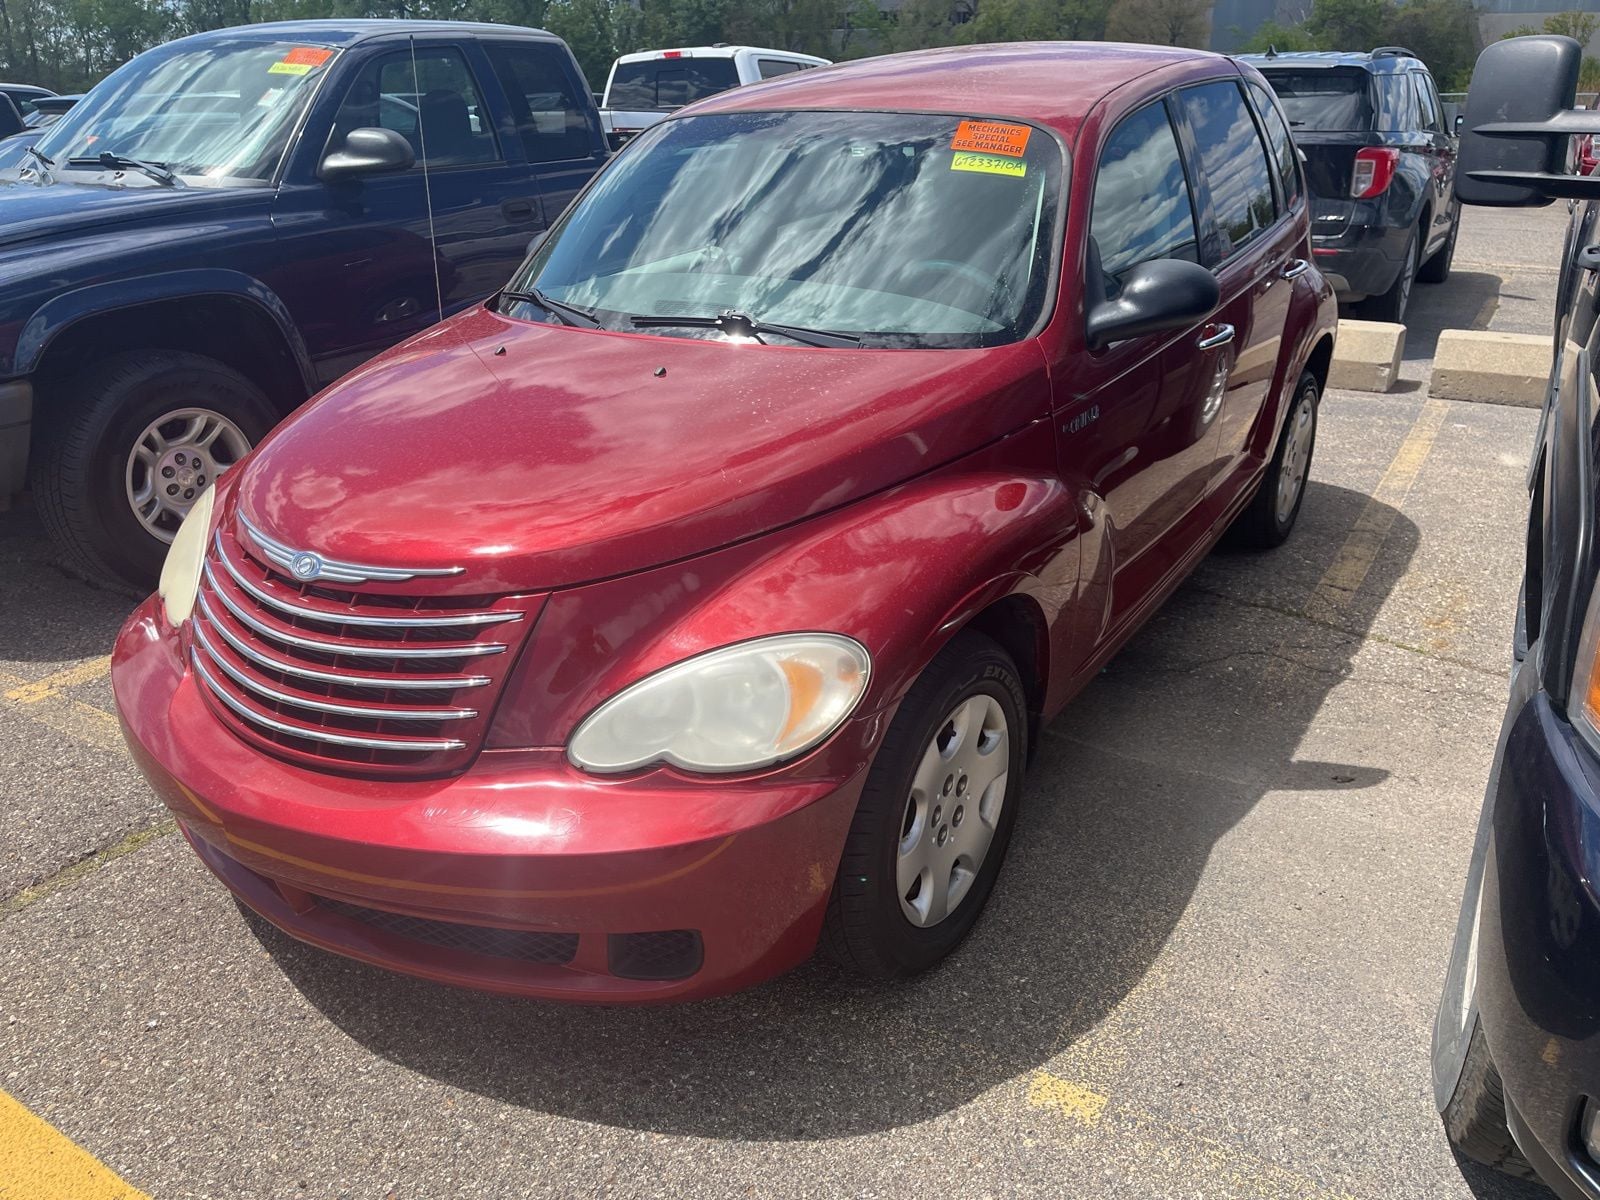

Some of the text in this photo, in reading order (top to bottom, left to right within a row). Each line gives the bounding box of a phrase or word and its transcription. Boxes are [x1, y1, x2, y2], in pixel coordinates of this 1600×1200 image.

[968, 124, 1022, 137] MECHANICS
[973, 132, 1010, 144] SPECIAL
[956, 140, 1022, 154] SEE MANAGER
